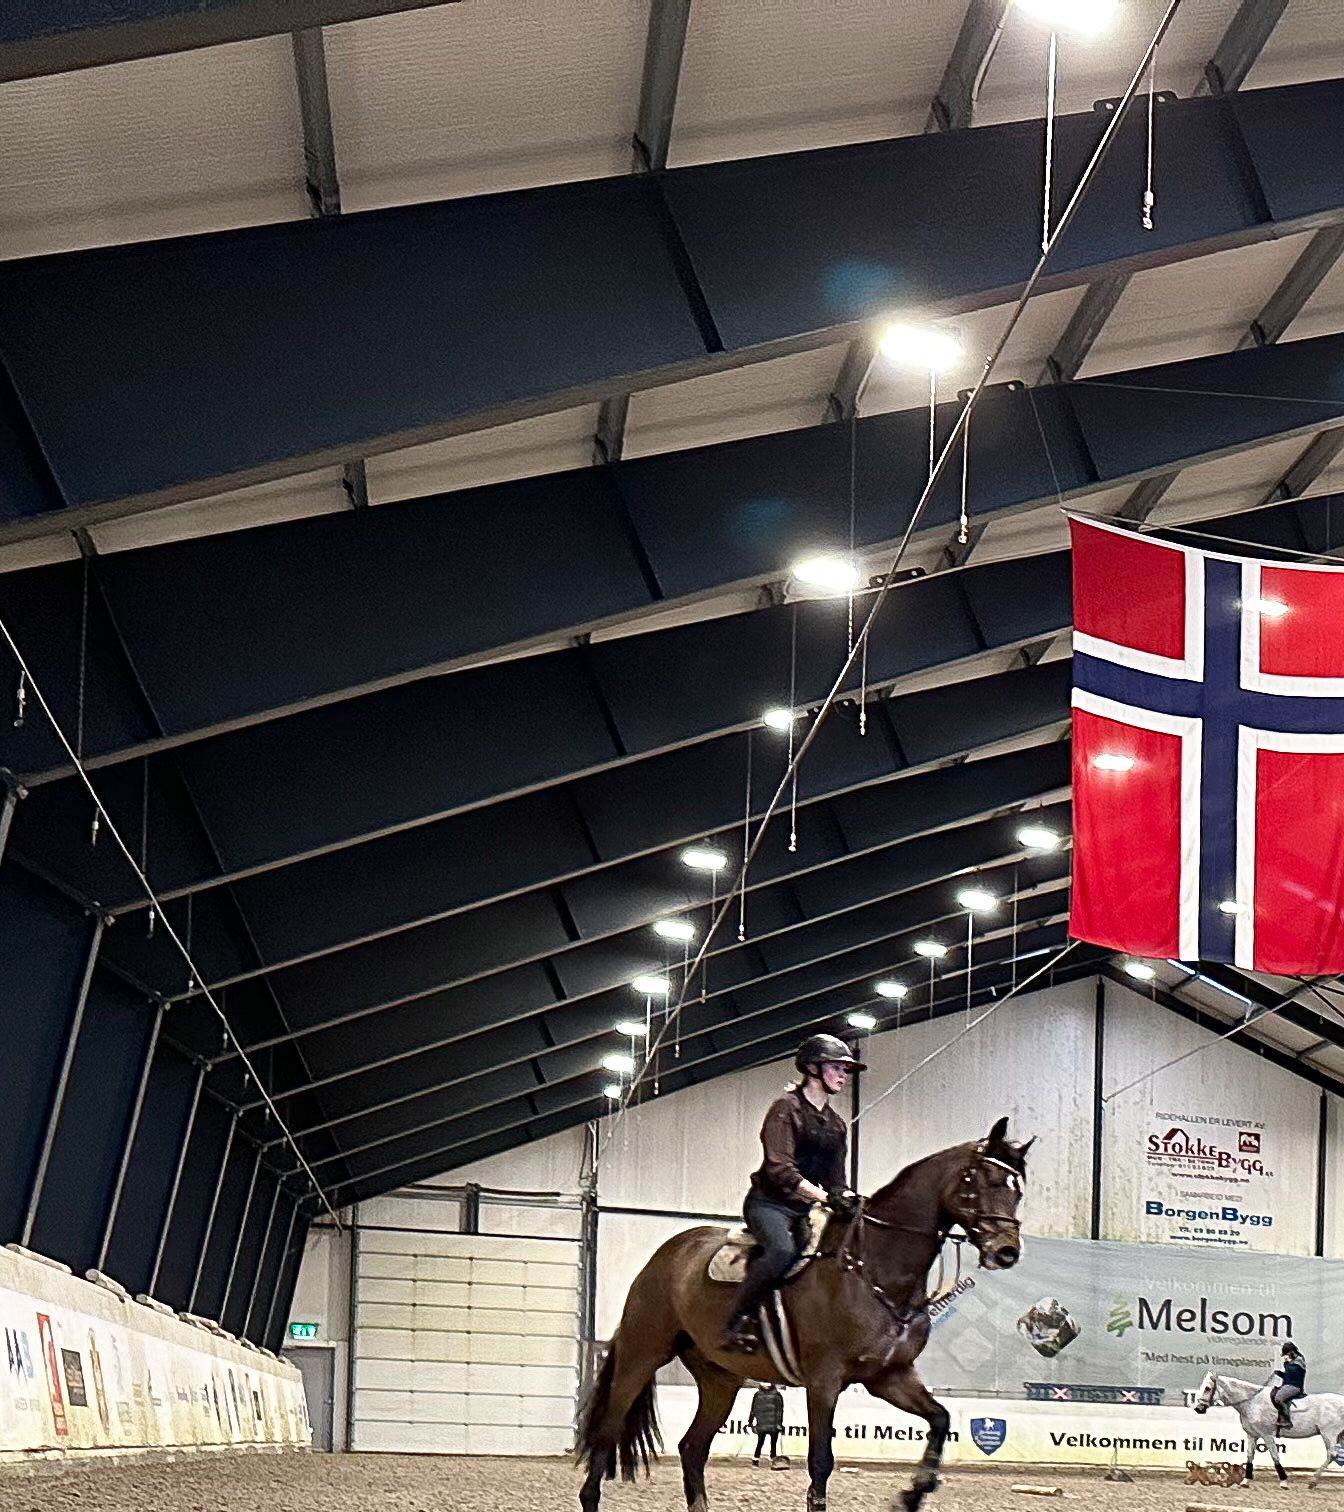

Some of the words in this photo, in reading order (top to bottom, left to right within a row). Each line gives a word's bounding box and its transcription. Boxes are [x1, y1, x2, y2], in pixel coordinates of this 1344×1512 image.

[1222, 1120, 1252, 1128] LEVERT
[1145, 1201, 1273, 1227] BorgenBygg
[1138, 1297, 1292, 1338] Melsom
[1171, 1353, 1194, 1364] hest
[1196, 1354, 1210, 1365] på
[844, 1424, 866, 1439] til
[1050, 1432, 1176, 1450] Velkommen
[1183, 1436, 1203, 1451] til
[1211, 1438, 1286, 1453] Melom
